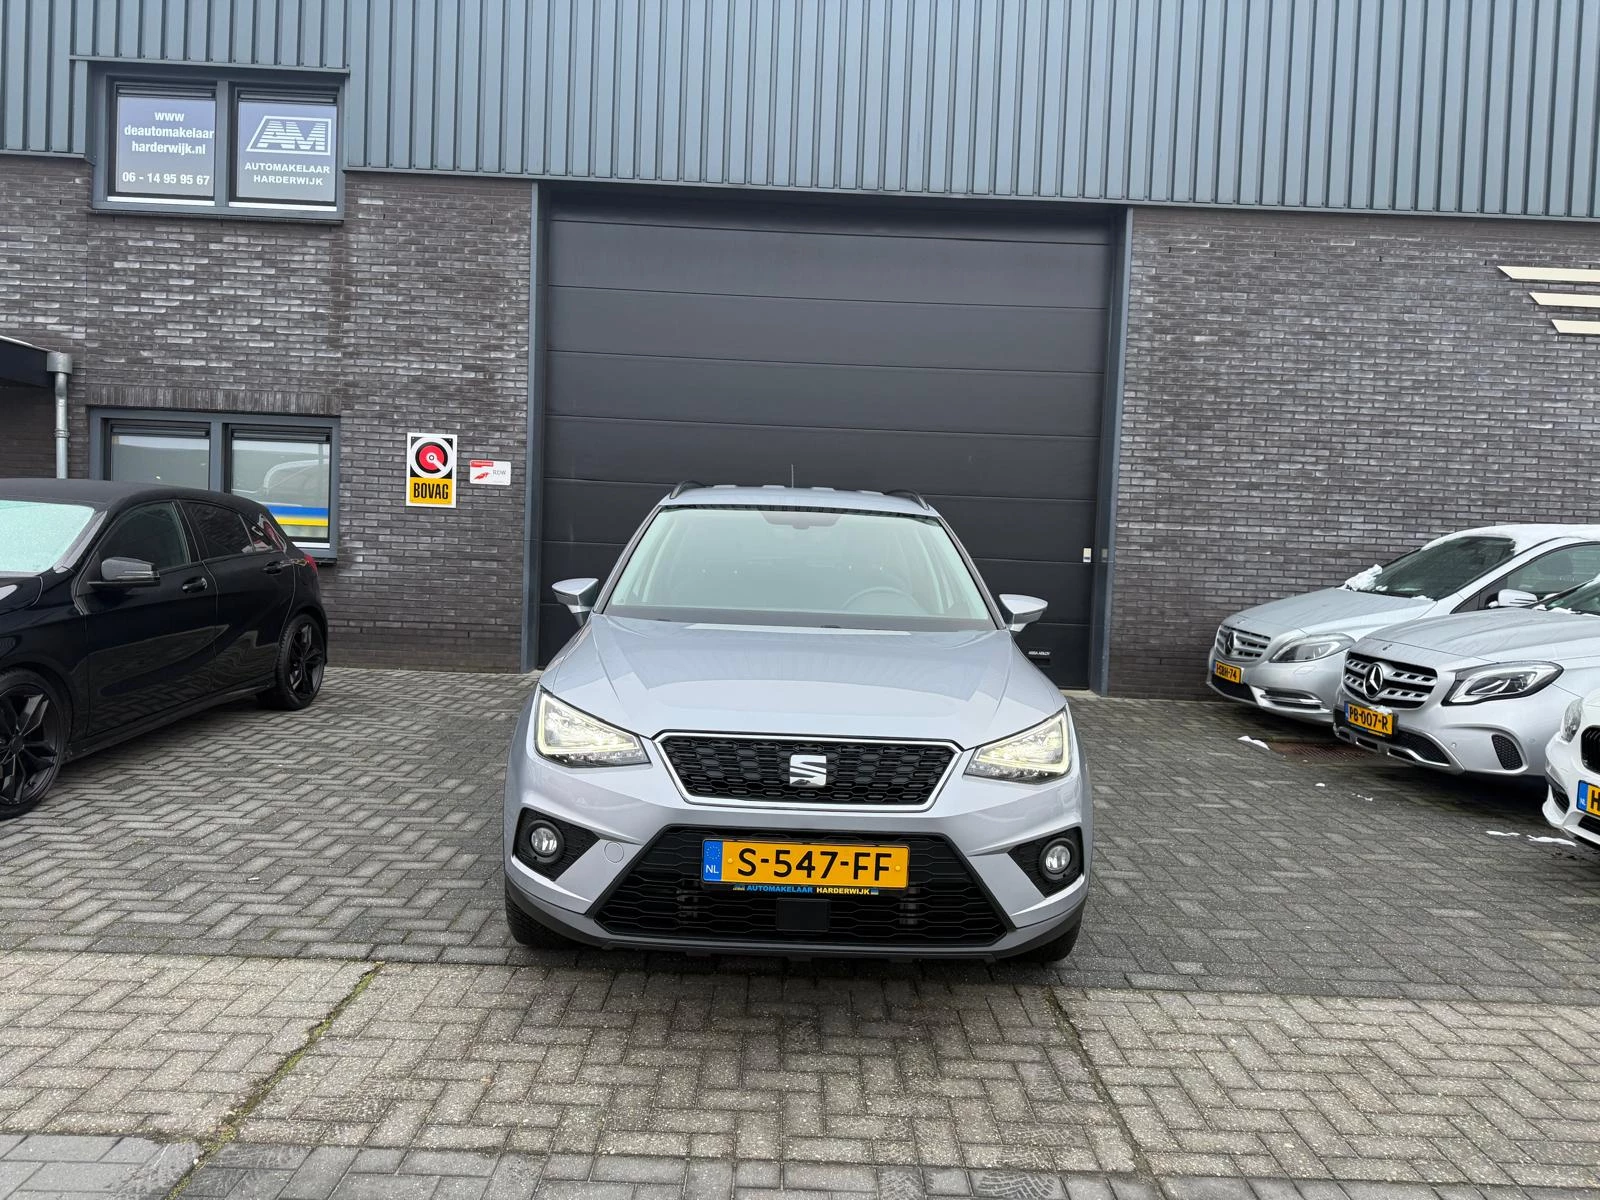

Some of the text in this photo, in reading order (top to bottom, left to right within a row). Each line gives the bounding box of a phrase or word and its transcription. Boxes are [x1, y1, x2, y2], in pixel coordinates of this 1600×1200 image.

[154, 112, 185, 122] www
[124, 125, 214, 139] deautomakelaar
[256, 120, 327, 151] AM
[131, 141, 206, 156] harderwijk.nl
[245, 162, 330, 174] AUTOMAKELAAR
[122, 172, 136, 182] 06
[147, 173, 161, 183] 14
[163, 174, 177, 184] 95
[180, 174, 193, 185] 95
[196, 175, 210, 185] 67
[253, 175, 323, 186] HARDERWIJK
[413, 482, 449, 500] BOVAG
[1349, 706, 1389, 731] PB-007-R
[705, 864, 719, 874] NL
[737, 847, 893, 882] S-547-FF
[746, 885, 870, 895] AUTOMAKELAAR HARDERWIJK
